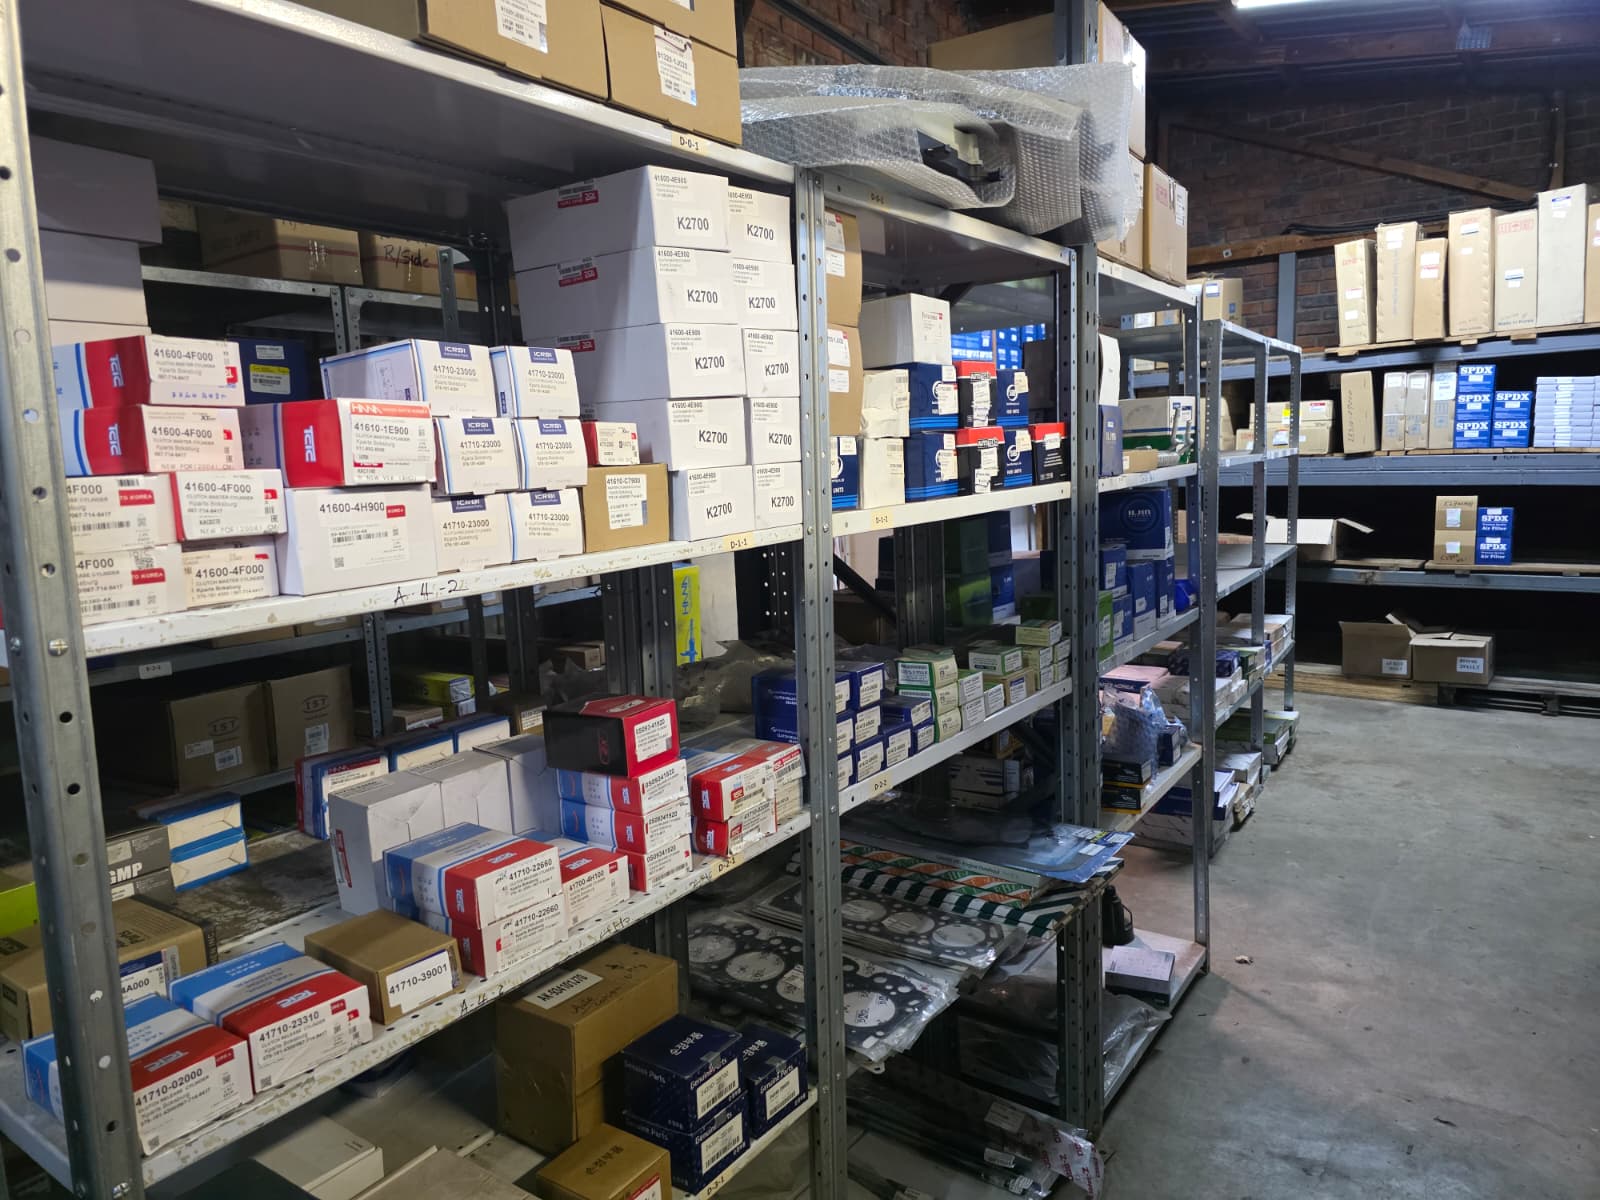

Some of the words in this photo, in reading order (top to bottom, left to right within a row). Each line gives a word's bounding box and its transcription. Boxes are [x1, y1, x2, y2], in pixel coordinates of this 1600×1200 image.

[679, 136, 699, 150] D-0-1
[677, 216, 709, 231] K2700
[747, 224, 774, 241] K2700
[383, 244, 430, 269] R/Side
[687, 289, 718, 303] K2700
[749, 297, 776, 309] K2700
[153, 348, 214, 362] 41600-4F000
[694, 355, 725, 370] K2700
[765, 362, 789, 377] K2700
[1460, 366, 1493, 375] SPDX
[1458, 394, 1490, 402] SPDX
[1496, 393, 1530, 401] SPDX
[354, 422, 409, 435] 41610-1E900
[1456, 422, 1488, 430] SPDX
[1494, 421, 1528, 429] SPDX
[152, 426, 213, 439] 41600-4F000
[698, 429, 728, 444] K2700
[769, 432, 792, 446] K2700
[303, 425, 317, 463] TCIC
[460, 440, 502, 449] 41710-23000
[185, 482, 251, 493] 41600-4F000
[320, 502, 385, 514] 41600-4H900
[771, 495, 795, 508] K2700
[528, 512, 570, 522] 41710-23000
[706, 502, 733, 519] K2700
[443, 519, 490, 530] 41710-23000
[730, 537, 748, 549] D-1-1
[195, 564, 264, 578] 41600-4F000
[509, 858, 553, 881] 41710-22660
[514, 903, 559, 927] 41710-22660
[389, 963, 448, 995] 41710-39001
[259, 1011, 319, 1042] 41710-23310
[136, 1067, 203, 1106] 41710-02000
